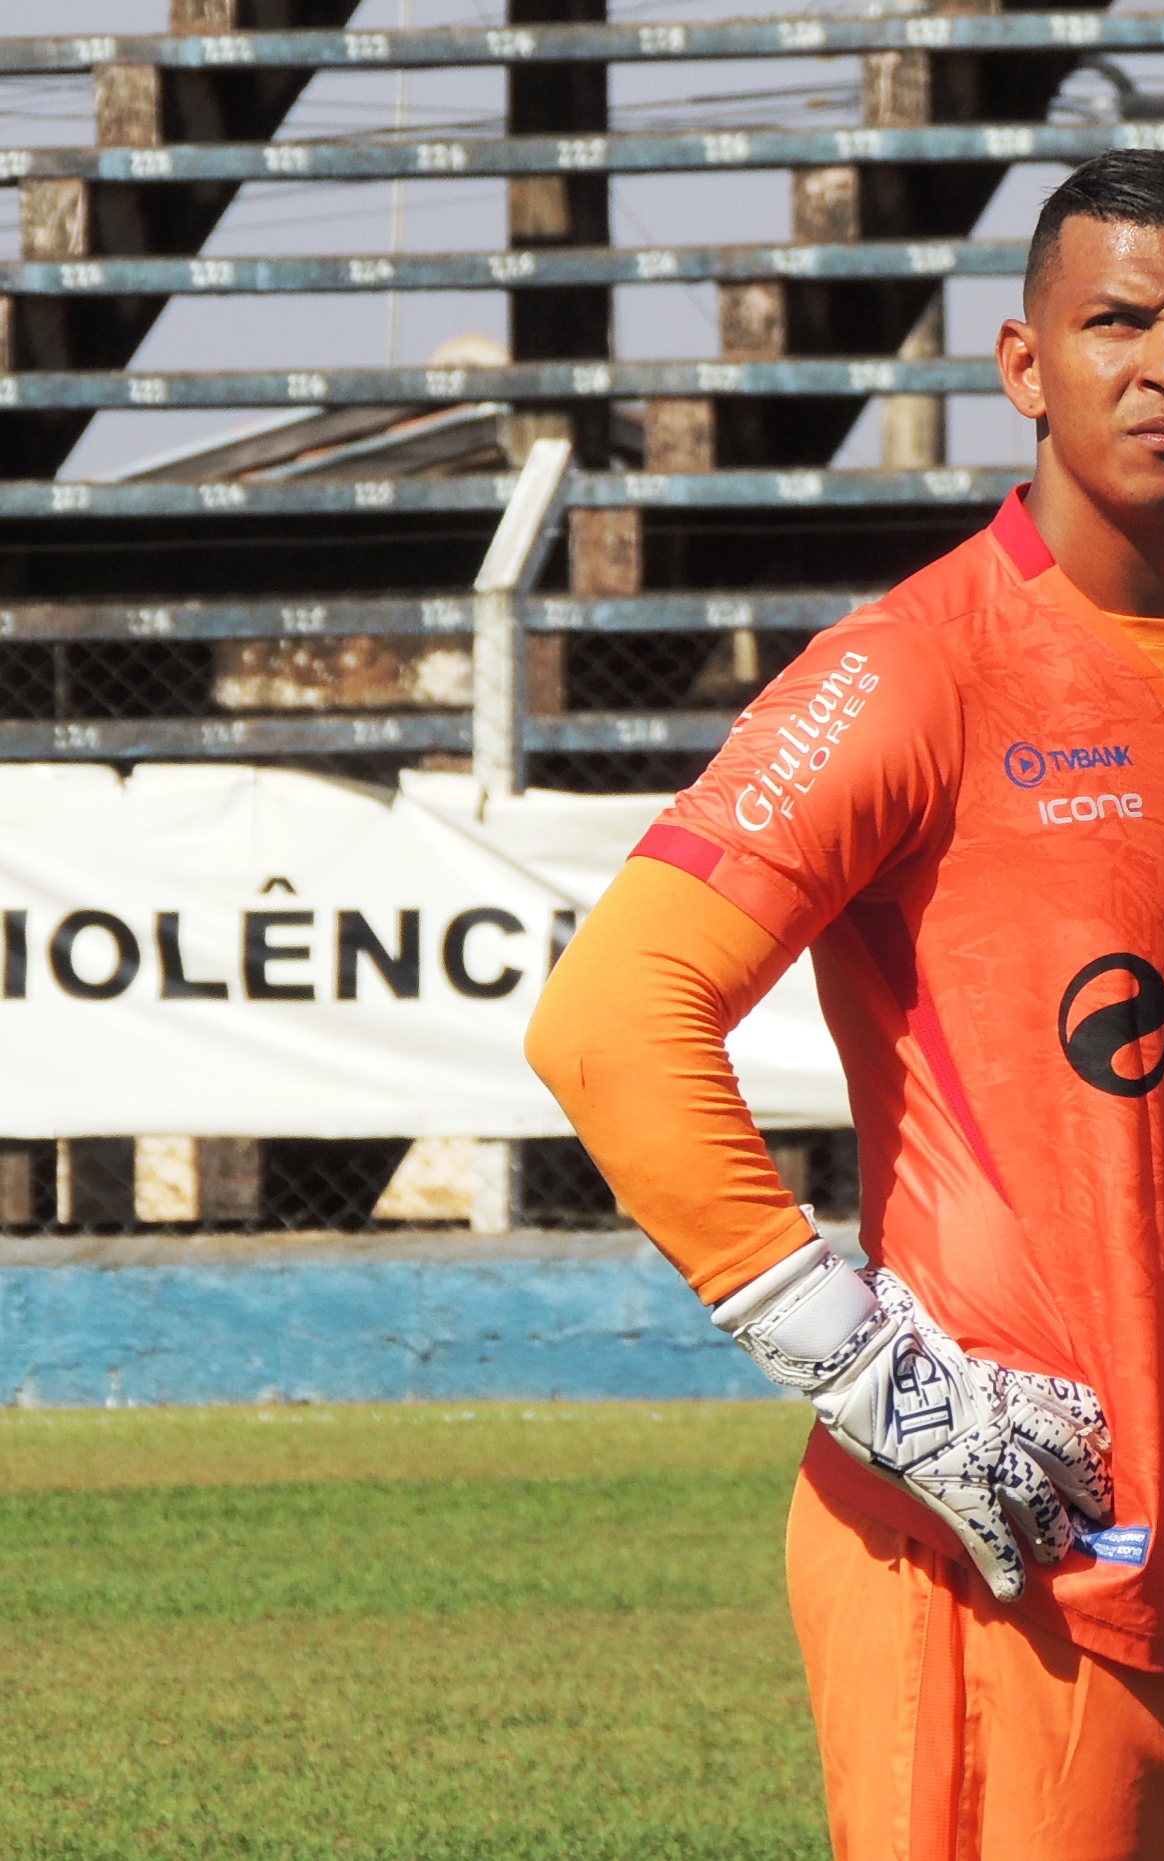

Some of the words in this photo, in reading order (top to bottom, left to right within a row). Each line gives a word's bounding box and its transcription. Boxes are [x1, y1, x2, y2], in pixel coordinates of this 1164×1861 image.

[735, 651, 868, 832] Giuliana
[779, 673, 881, 820] FLORES
[1047, 745, 1134, 771] TVBANK
